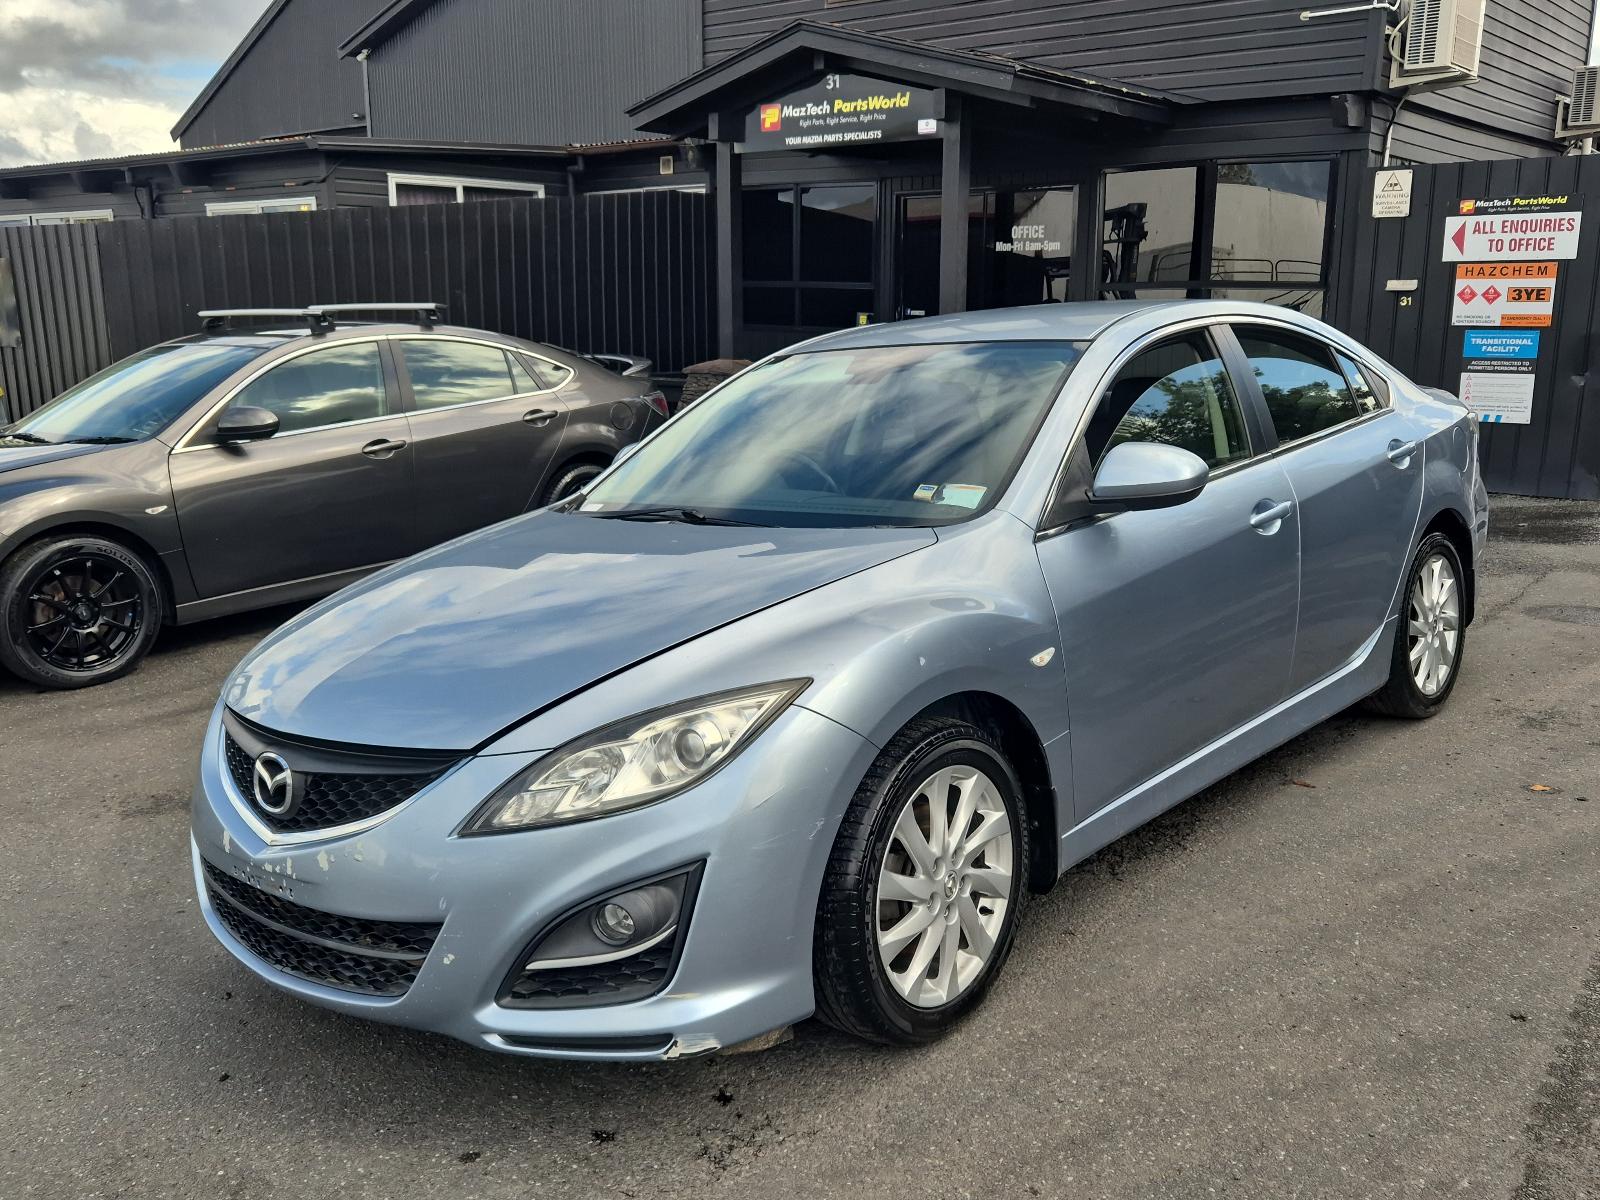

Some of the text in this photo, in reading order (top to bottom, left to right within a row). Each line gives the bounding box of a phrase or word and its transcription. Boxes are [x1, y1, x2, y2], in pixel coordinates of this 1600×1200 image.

[826, 74, 840, 89] 31
[782, 92, 910, 118] MazTech PartsWorld
[799, 119, 812, 128] Right
[826, 116, 840, 126] Right
[860, 113, 873, 123] Right
[873, 112, 886, 120] Price
[785, 130, 882, 145] YOUR MAZDA PARTS SPECIALISTS
[1476, 196, 1568, 207] MazTech PartsWorld
[1012, 225, 1045, 238] OFFICE
[1472, 217, 1576, 234] ALL ENQUIRIES
[996, 240, 1060, 252] Mon-Fri 8am-5pm
[1487, 237, 1555, 252] TO OFFICE
[1465, 265, 1548, 276] HAZCHEM
[1400, 296, 1412, 306] 31
[1511, 288, 1546, 301] 3YE
